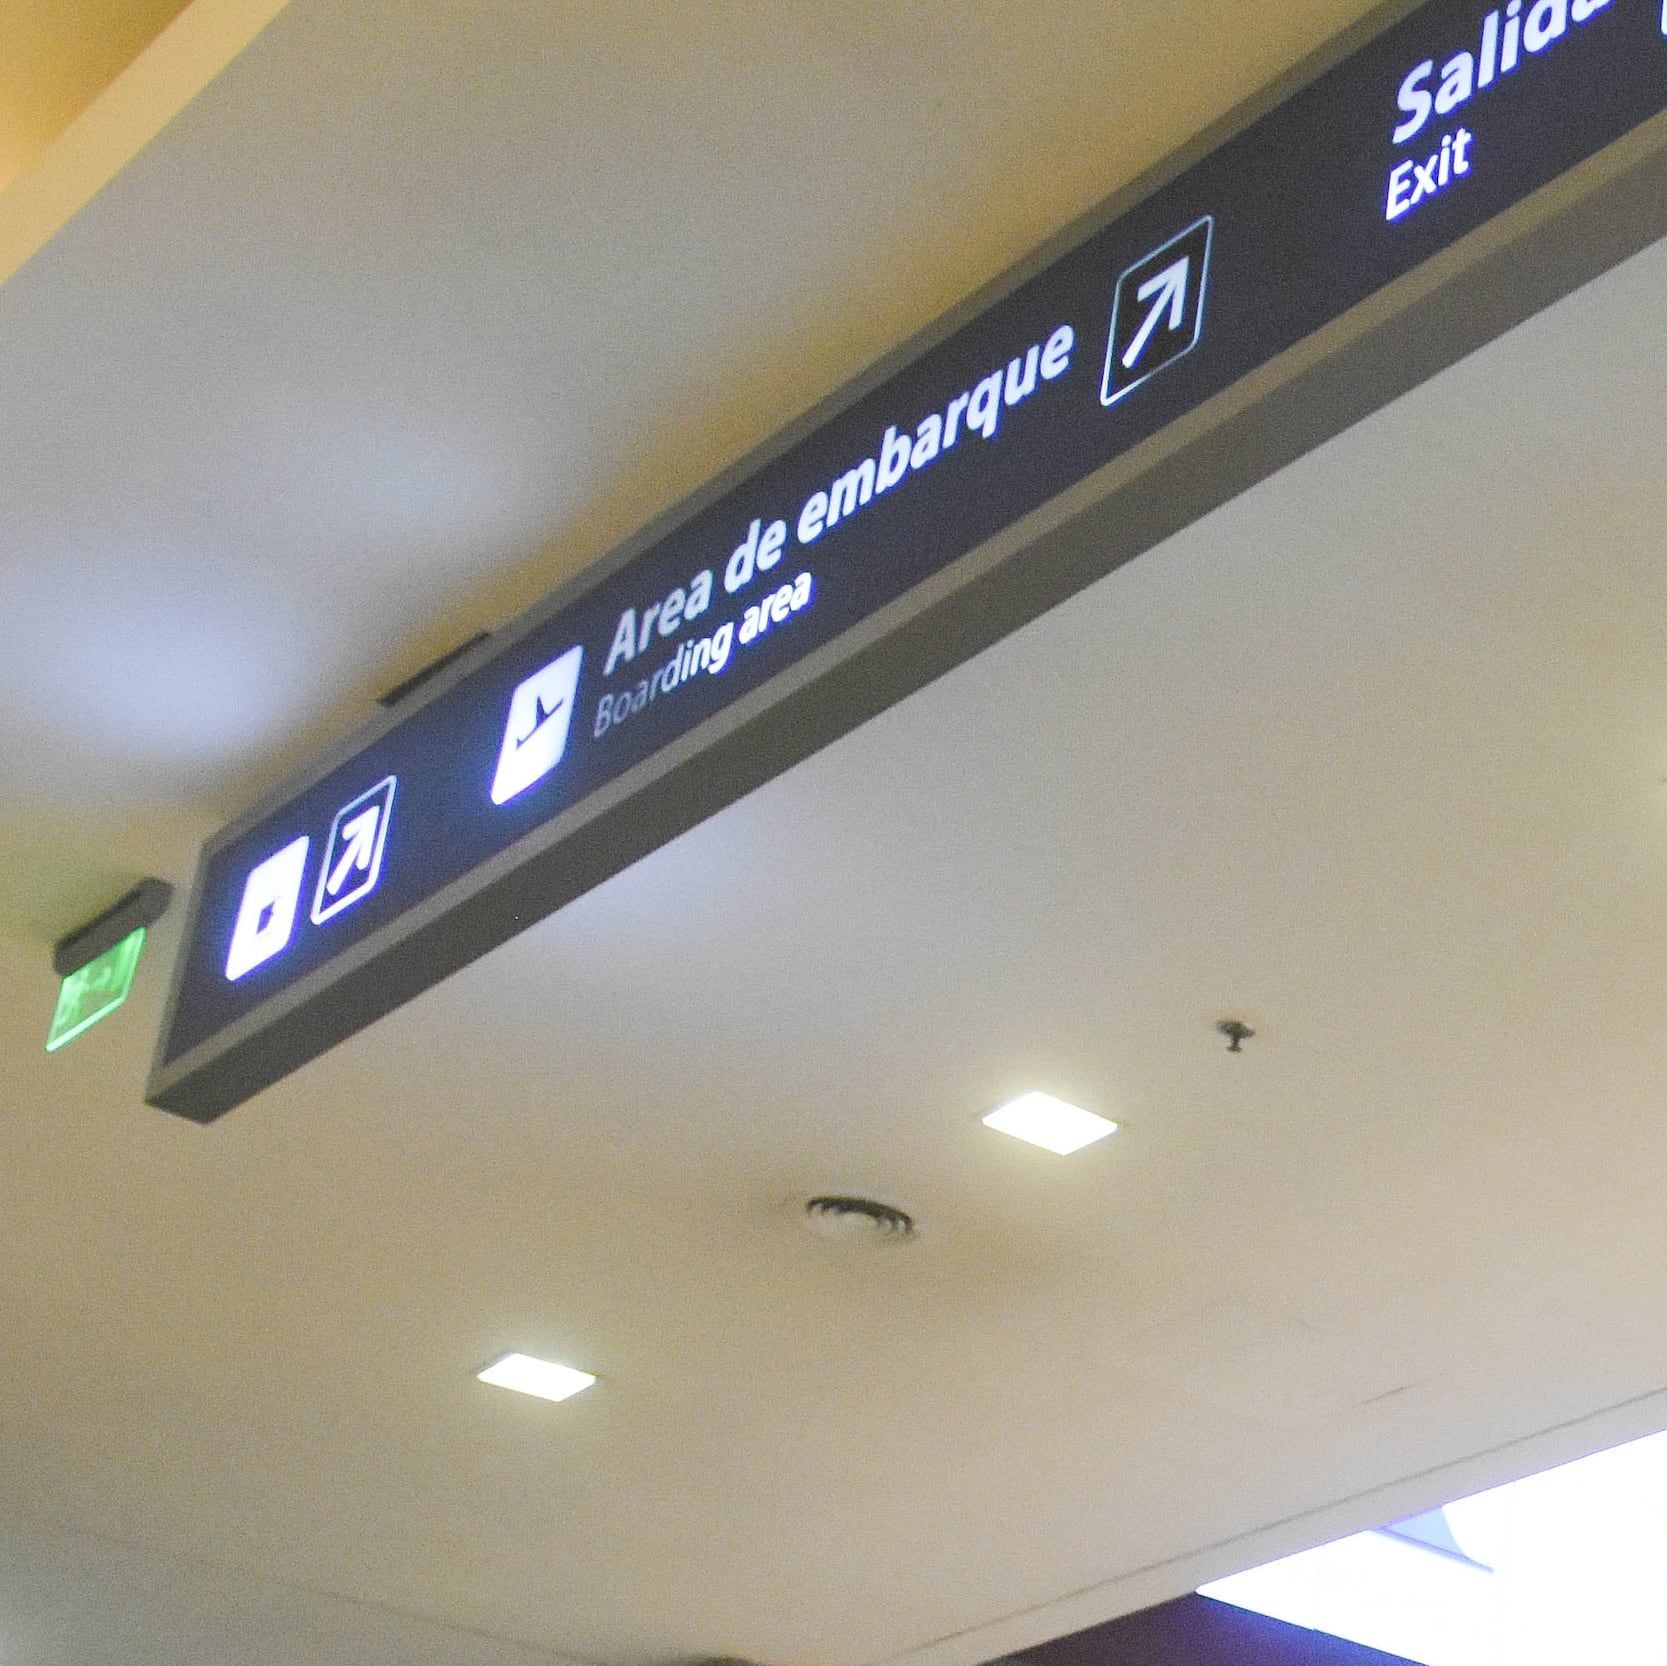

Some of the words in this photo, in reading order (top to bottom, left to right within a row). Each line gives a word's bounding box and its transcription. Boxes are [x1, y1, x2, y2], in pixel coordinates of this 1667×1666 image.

[1386, 128, 1471, 221] Exit
[602, 569, 713, 677] Area
[724, 517, 787, 593] de
[797, 324, 1074, 544] embarque
[593, 622, 735, 738] Boarding
[738, 572, 812, 645] area
